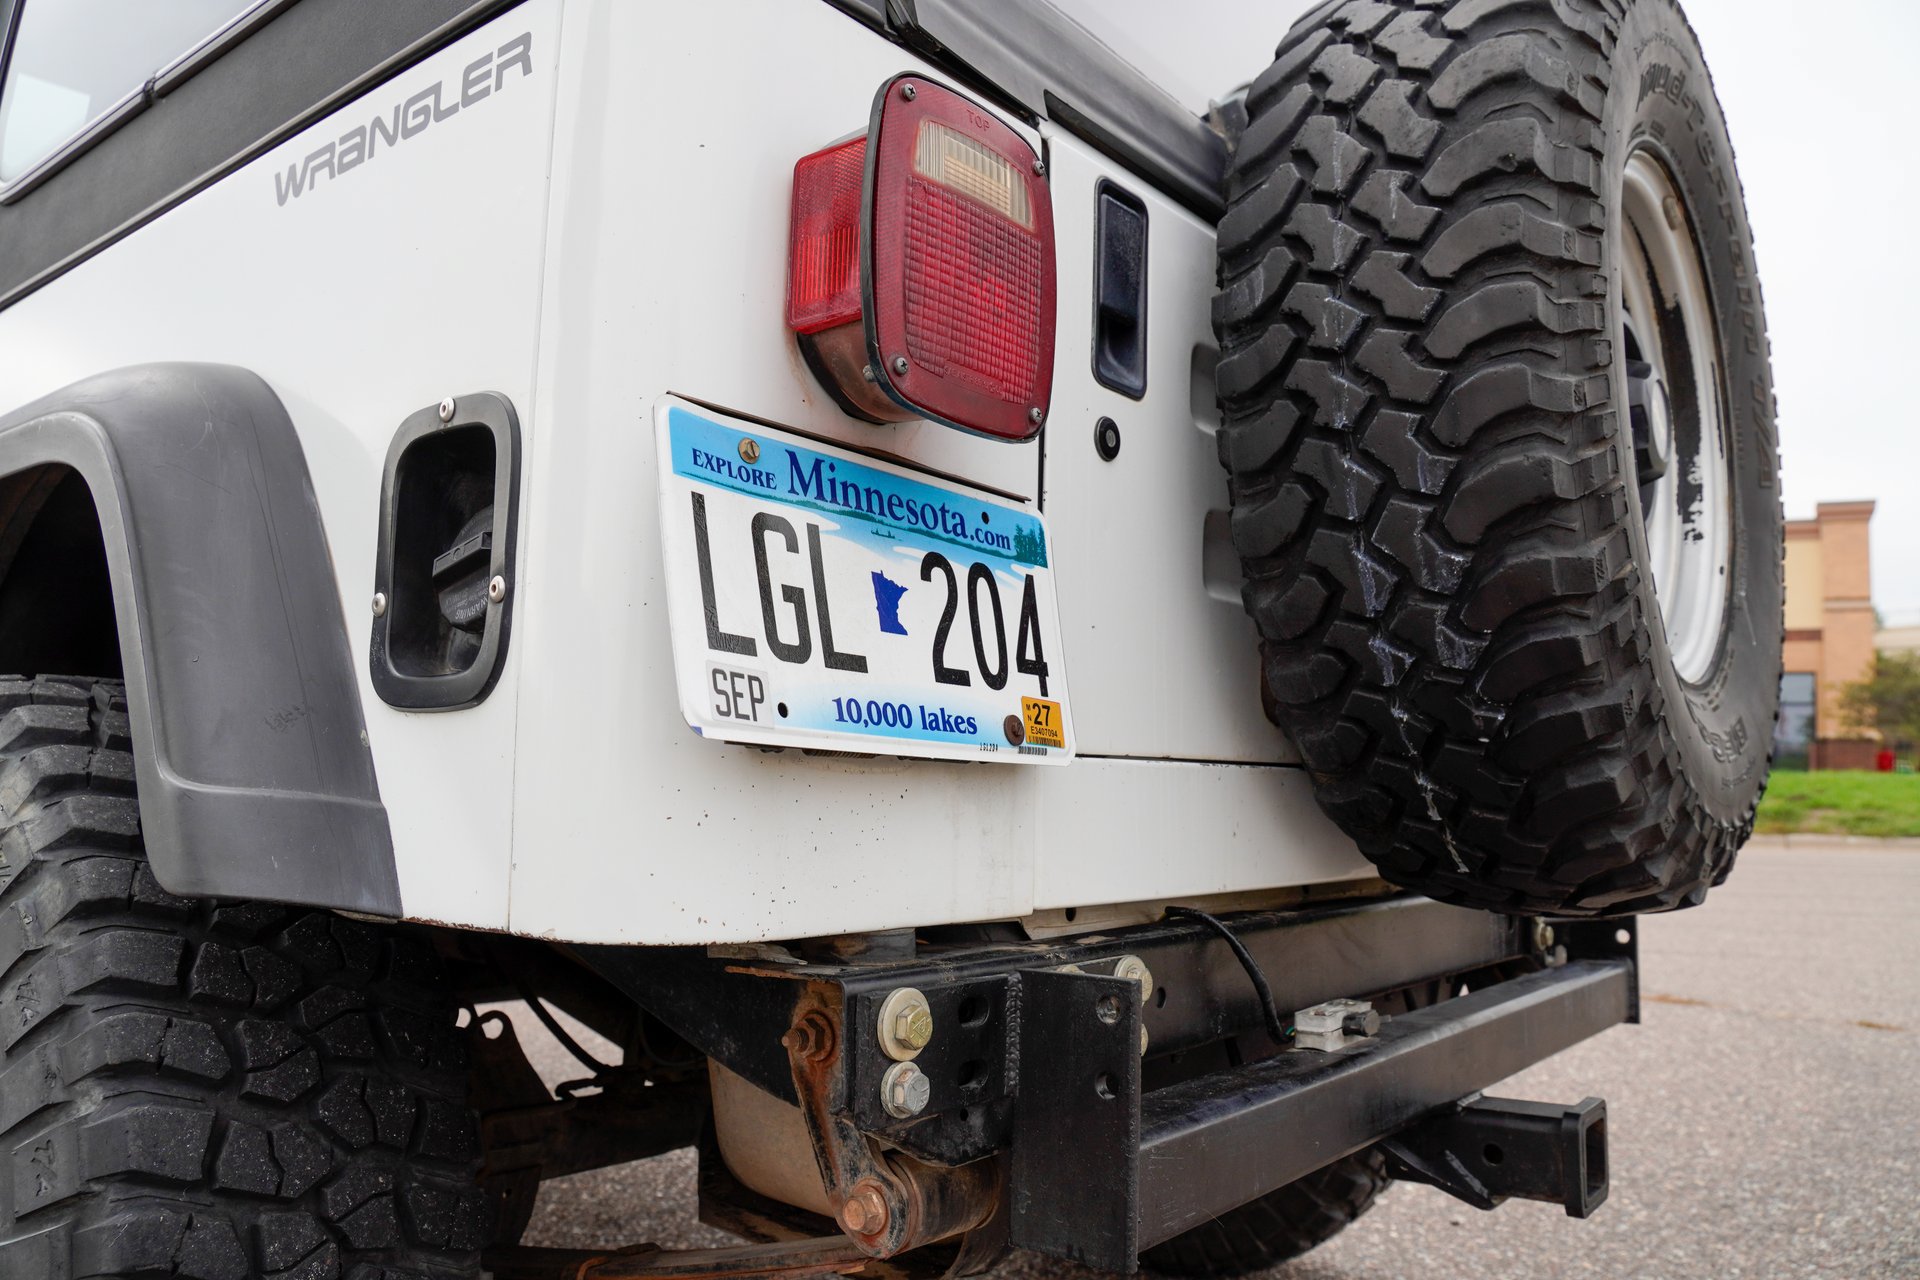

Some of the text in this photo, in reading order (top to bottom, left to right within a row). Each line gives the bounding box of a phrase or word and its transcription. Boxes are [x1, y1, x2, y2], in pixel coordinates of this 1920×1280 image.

[274, 31, 533, 207] WRANGLER
[966, 109, 990, 131] TOP
[692, 447, 1012, 551] EXPLORE Minnesota.com
[690, 490, 1050, 697] LGL 204
[711, 667, 765, 722] SEP
[832, 697, 978, 735] 10,000 lakes
[1032, 702, 1051, 727] 27
